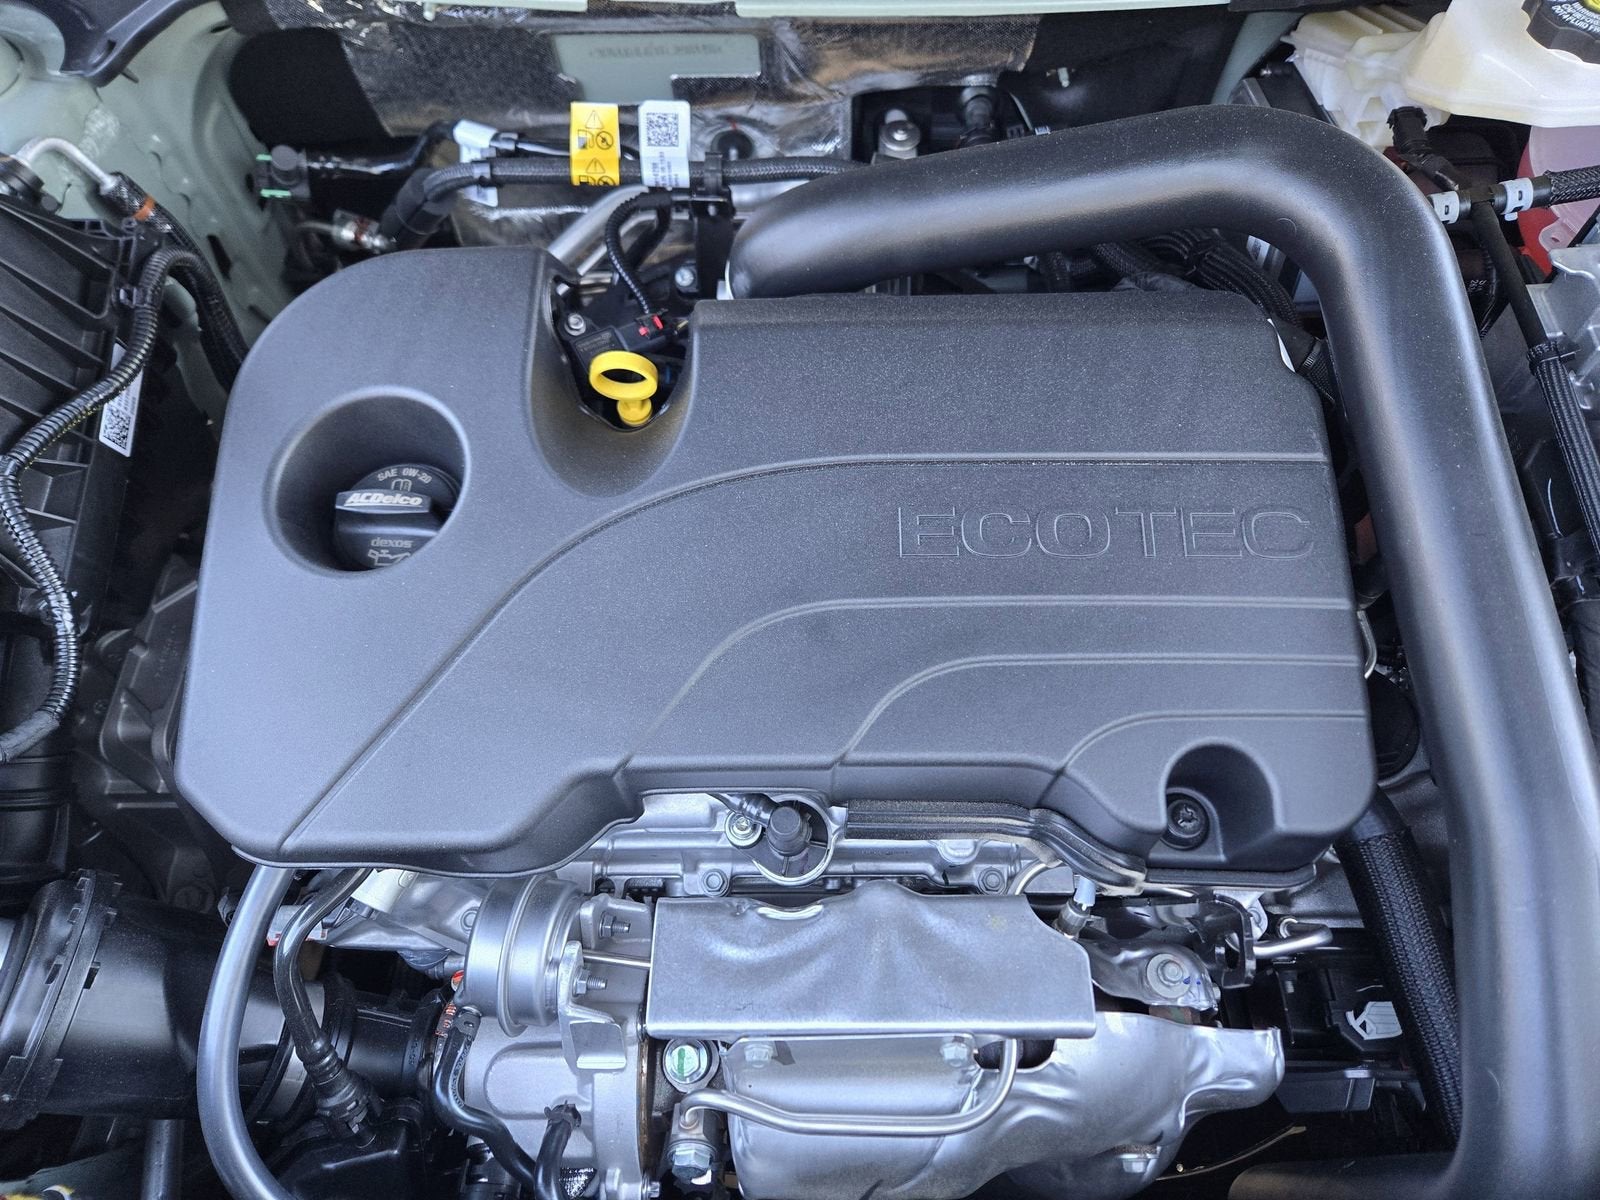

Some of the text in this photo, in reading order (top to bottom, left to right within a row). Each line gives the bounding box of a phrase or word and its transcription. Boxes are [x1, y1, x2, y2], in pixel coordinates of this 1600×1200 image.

[377, 468, 432, 483] SAE 0W-20
[345, 493, 423, 507] ACDelco
[899, 506, 1314, 561] ECOTEC
[370, 537, 414, 548] dexos
